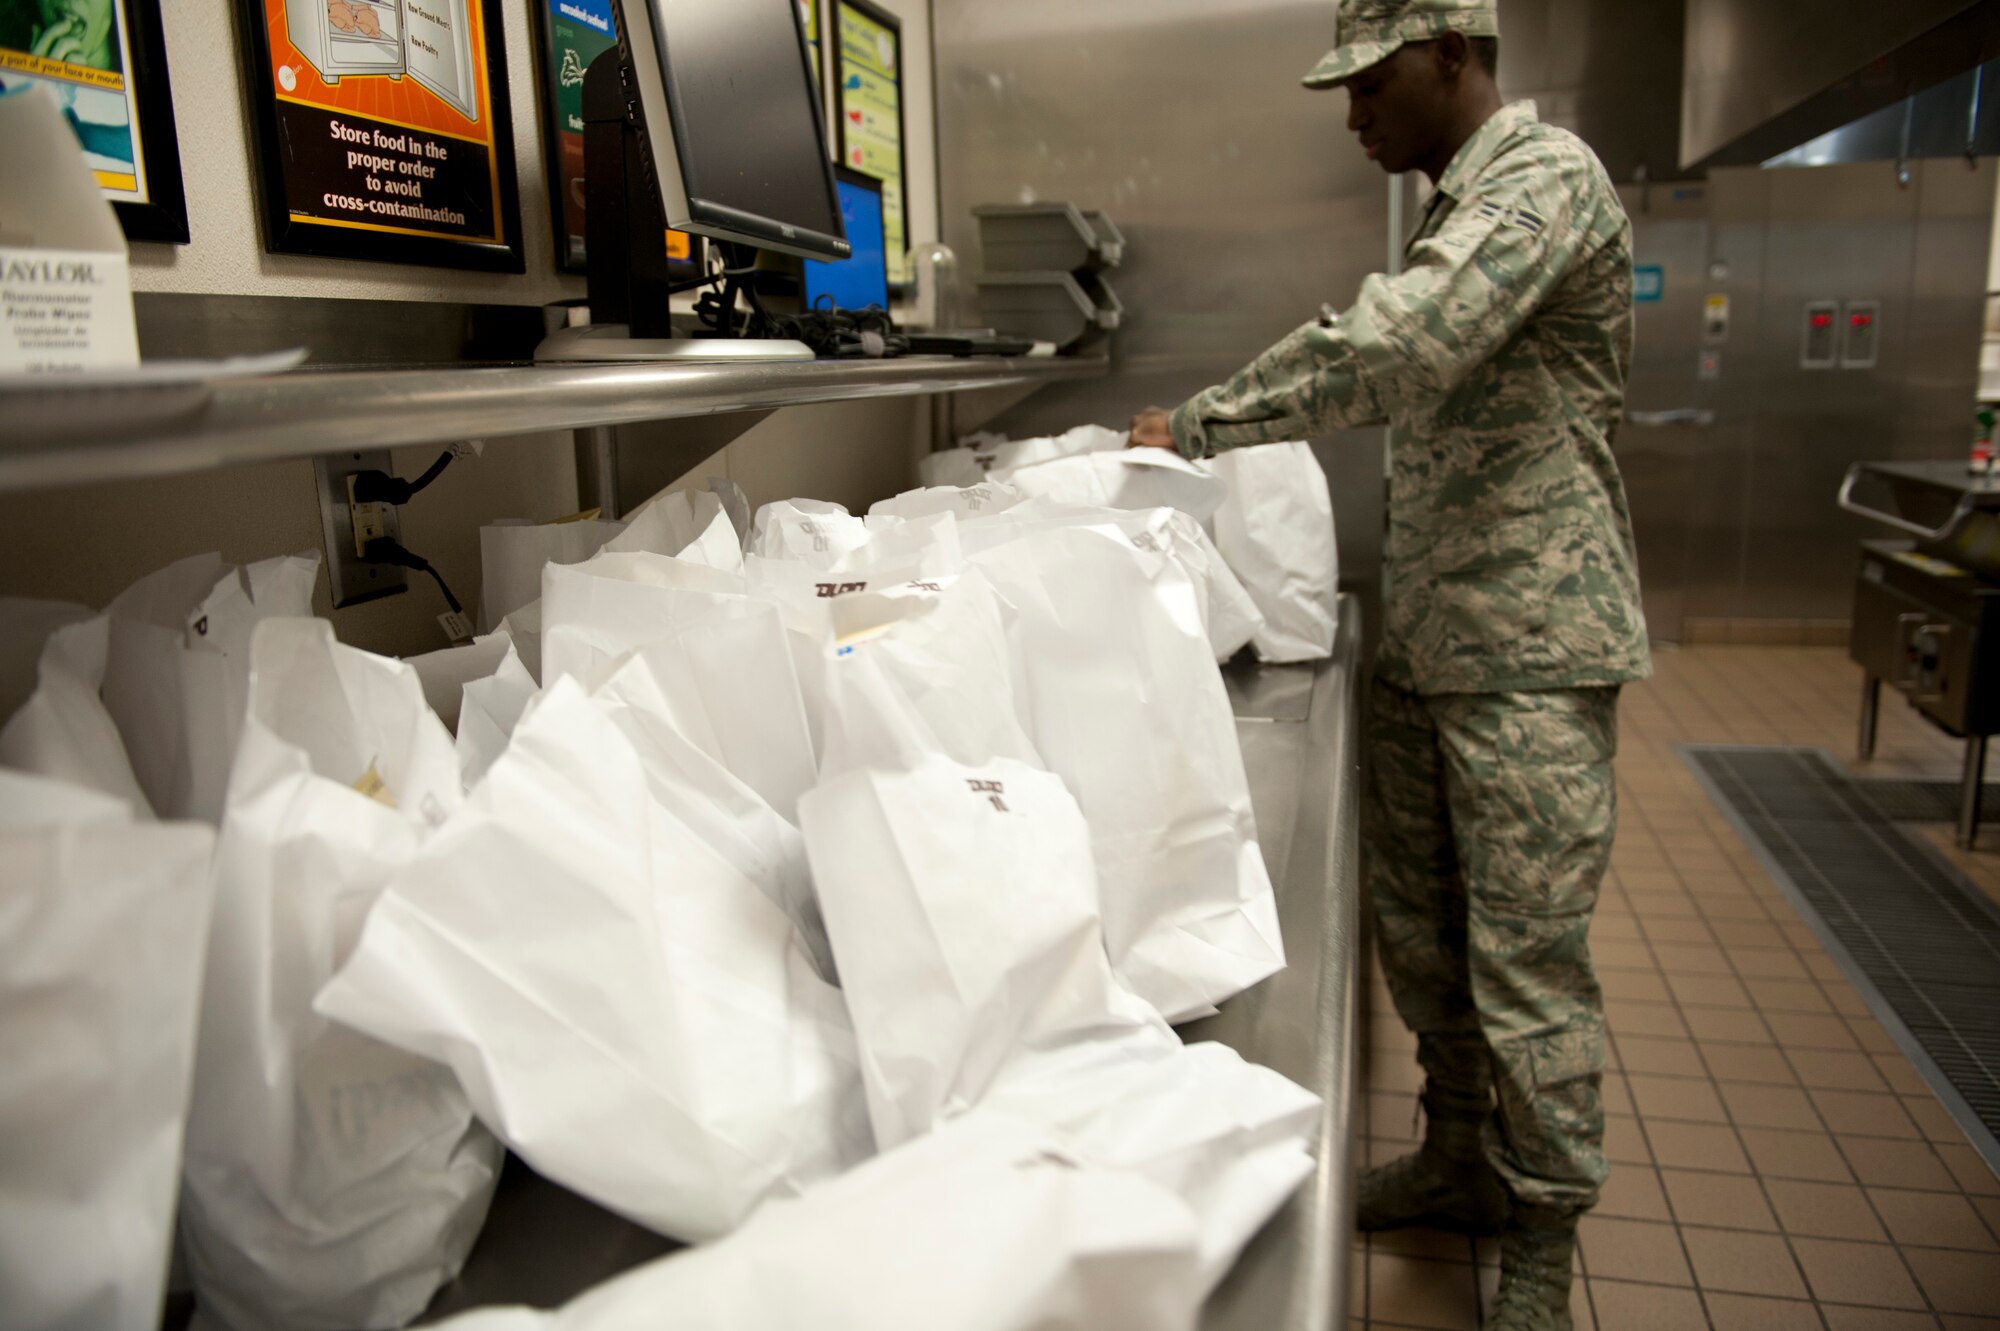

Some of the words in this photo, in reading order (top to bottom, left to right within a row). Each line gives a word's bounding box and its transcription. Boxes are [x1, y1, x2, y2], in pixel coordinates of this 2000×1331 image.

[408, 1, 418, 14] Raw
[418, 7, 436, 23] Ground
[435, 15, 451, 31] Meats
[411, 34, 422, 48] Raw
[421, 40, 439, 60] Poultry
[7, 56, 27, 67] part
[29, 58, 39, 68] of
[41, 62, 62, 73] your
[64, 64, 83, 77] face
[96, 74, 123, 85] mouth
[329, 120, 371, 145] Store
[373, 130, 406, 152] food
[408, 137, 422, 156] in
[424, 142, 448, 160] the
[347, 150, 396, 174] proper
[398, 160, 436, 180] order
[365, 174, 382, 192] to
[384, 180, 422, 198] avoid
[323, 193, 466, 226] cross-contamination
